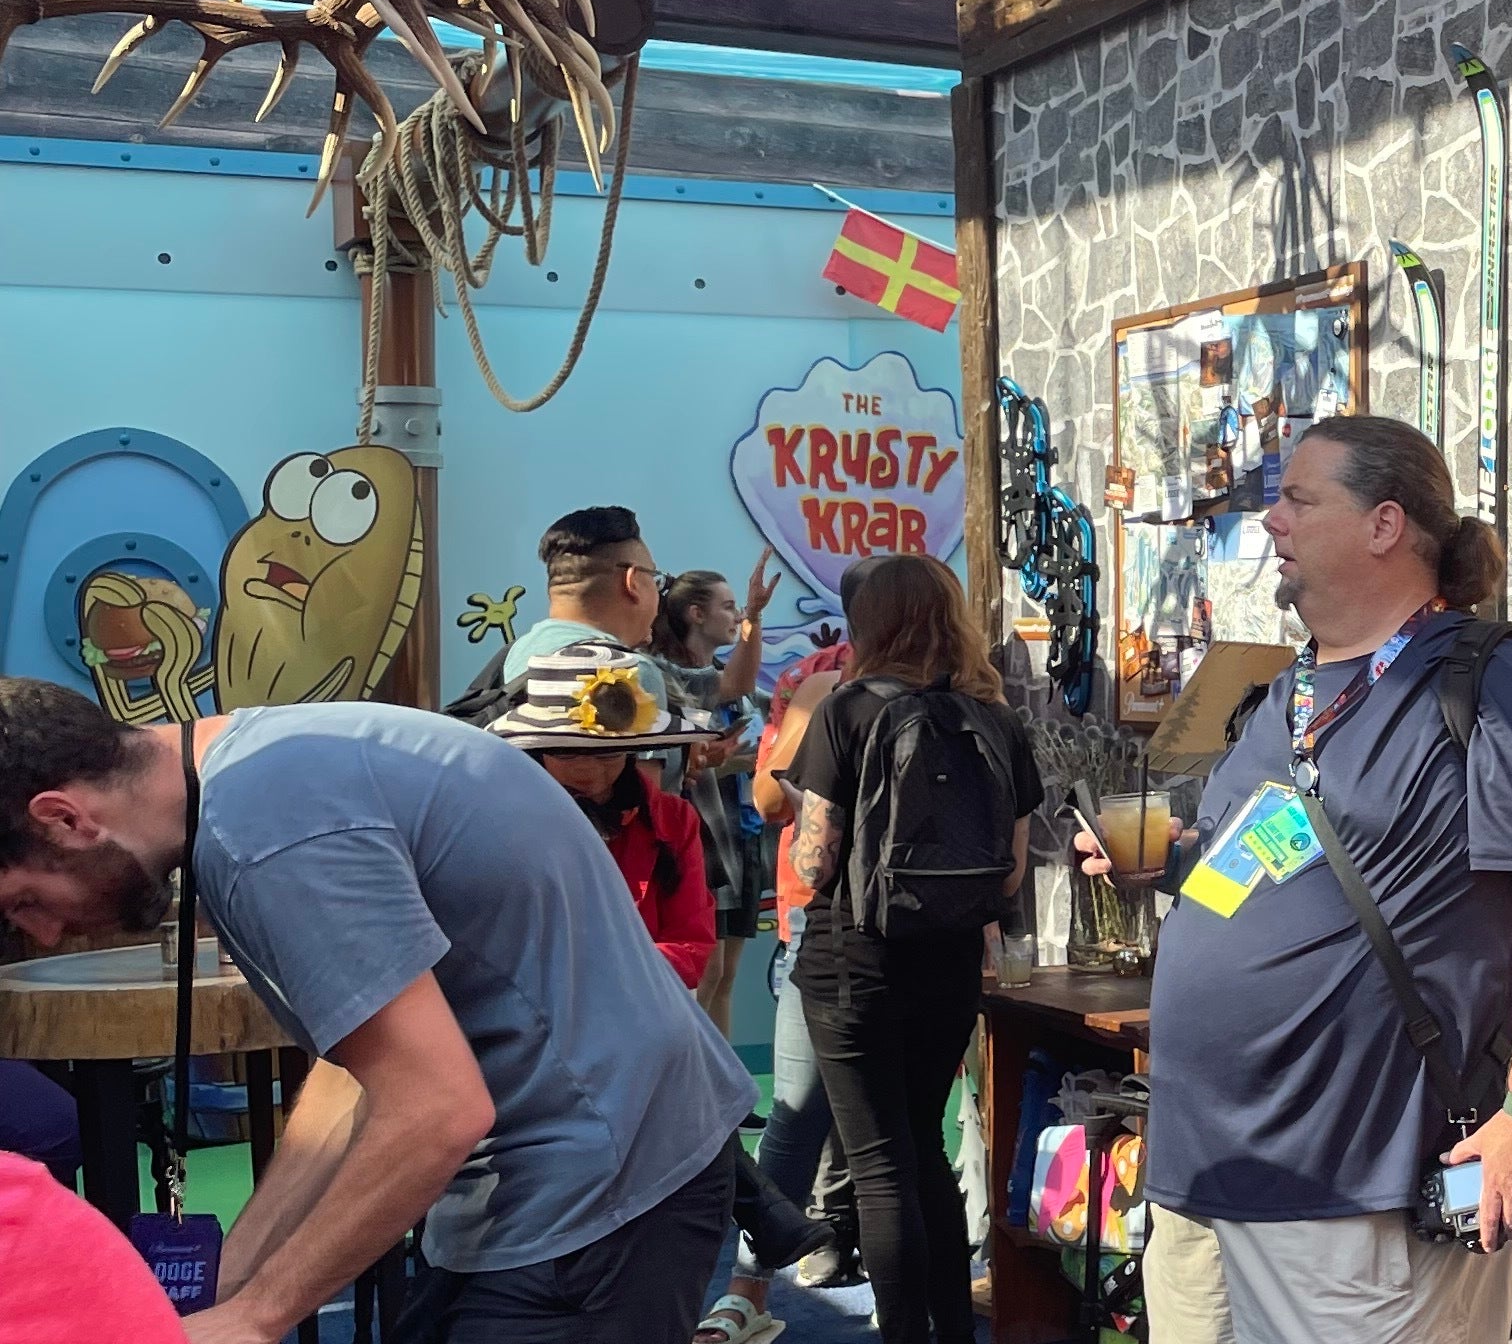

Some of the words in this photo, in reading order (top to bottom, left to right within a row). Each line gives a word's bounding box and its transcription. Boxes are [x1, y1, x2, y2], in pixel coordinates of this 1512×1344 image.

[842, 393, 882, 416] THE
[1480, 328, 1499, 460] LODGE
[1479, 467, 1496, 525] HE
[154, 1260, 207, 1283] ODGE
